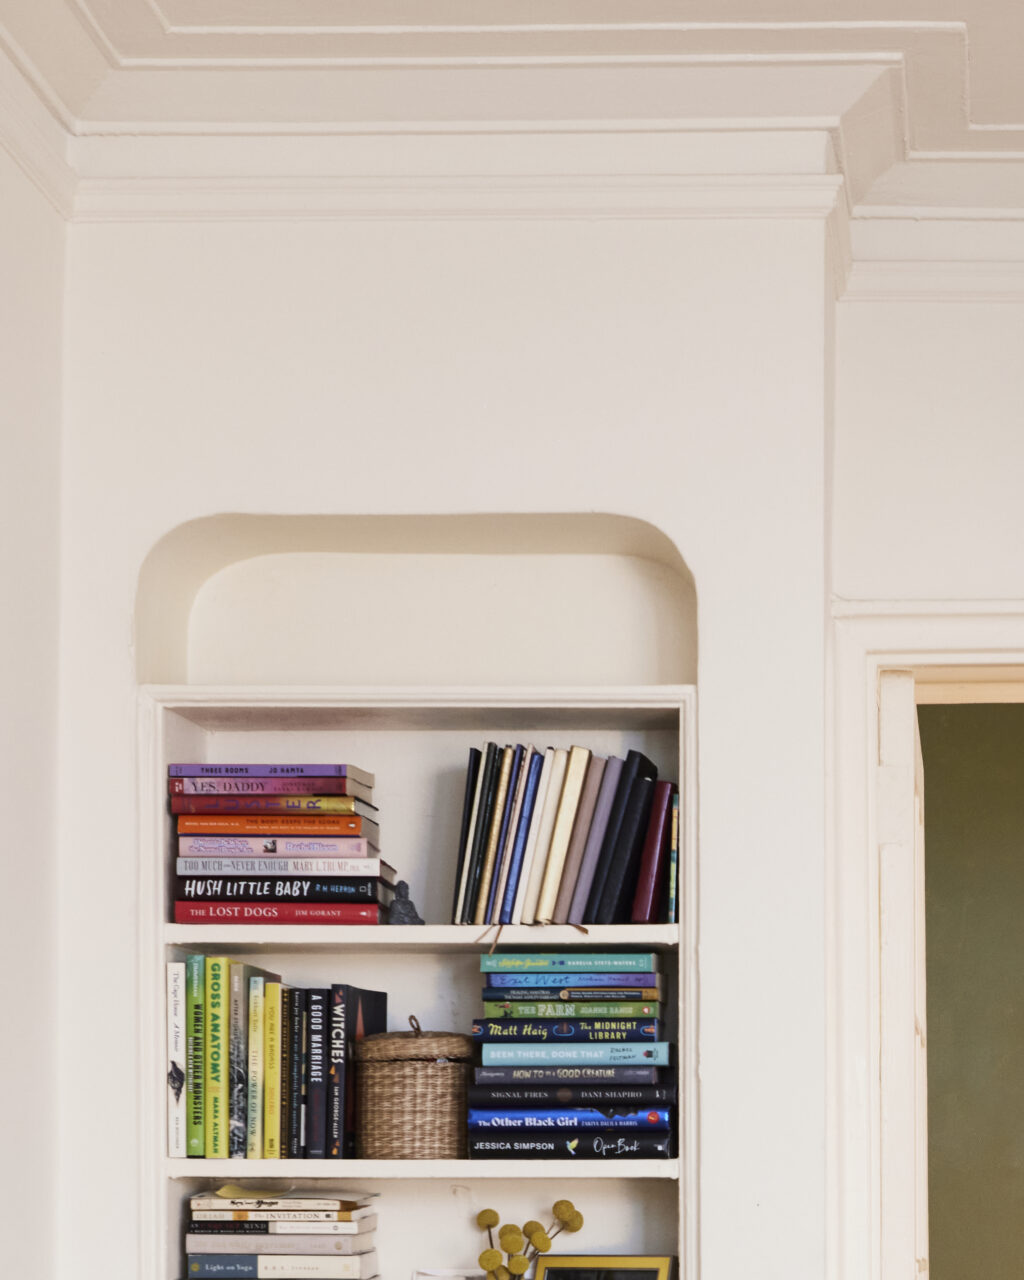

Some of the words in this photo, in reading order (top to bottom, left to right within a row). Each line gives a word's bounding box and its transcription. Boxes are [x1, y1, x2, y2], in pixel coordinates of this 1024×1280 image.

[191, 782, 220, 792] YES,
[223, 782, 267, 792] DADDY
[204, 798, 322, 811] LUSTER
[184, 860, 199, 872] TOO
[258, 860, 289, 872] ENOUGH
[293, 861, 314, 872] MARY
[185, 880, 223, 898] HUSH
[226, 882, 272, 896] LITTLE
[275, 881, 311, 896] BABY
[209, 906, 241, 917] LOST
[244, 907, 279, 917] DOGS
[535, 974, 570, 985] West
[211, 963, 221, 1009] GROSS
[518, 1006, 537, 1014] THE
[537, 1004, 576, 1016] FARM
[193, 1004, 204, 1034] WOMEN
[311, 1005, 322, 1030] GOOD
[488, 1022, 518, 1036] Matt
[522, 1023, 548, 1040] Haig
[579, 1022, 592, 1030] The
[594, 1021, 637, 1030] MIDNIGHT
[331, 1003, 346, 1064] WITCHES
[588, 1031, 628, 1040] LIBRARY
[193, 1036, 204, 1053] AND
[211, 1013, 221, 1083] ANATOMY
[311, 1034, 323, 1083] MARRIAGE
[490, 1050, 515, 1058] BEEN
[516, 1050, 550, 1059] THERE,
[551, 1050, 578, 1058] DONE
[581, 1050, 605, 1058] THAT
[193, 1054, 204, 1080] OTHER
[512, 1069, 532, 1079] HOW
[533, 1070, 544, 1078] TO
[557, 1068, 581, 1078] GOOD
[582, 1068, 616, 1078] CREATURE
[192, 1082, 203, 1126] MONSTERS
[250, 1102, 258, 1113] OF
[491, 1117, 523, 1126] Other
[524, 1117, 555, 1126] Black
[556, 1117, 578, 1126] Girl
[474, 1142, 511, 1150] JESSICA
[513, 1142, 555, 1150] SIMPSON
[593, 1137, 615, 1156] Open
[615, 1138, 640, 1154] Book
[204, 1264, 224, 1272] Light
[236, 1264, 253, 1272] Yoga
